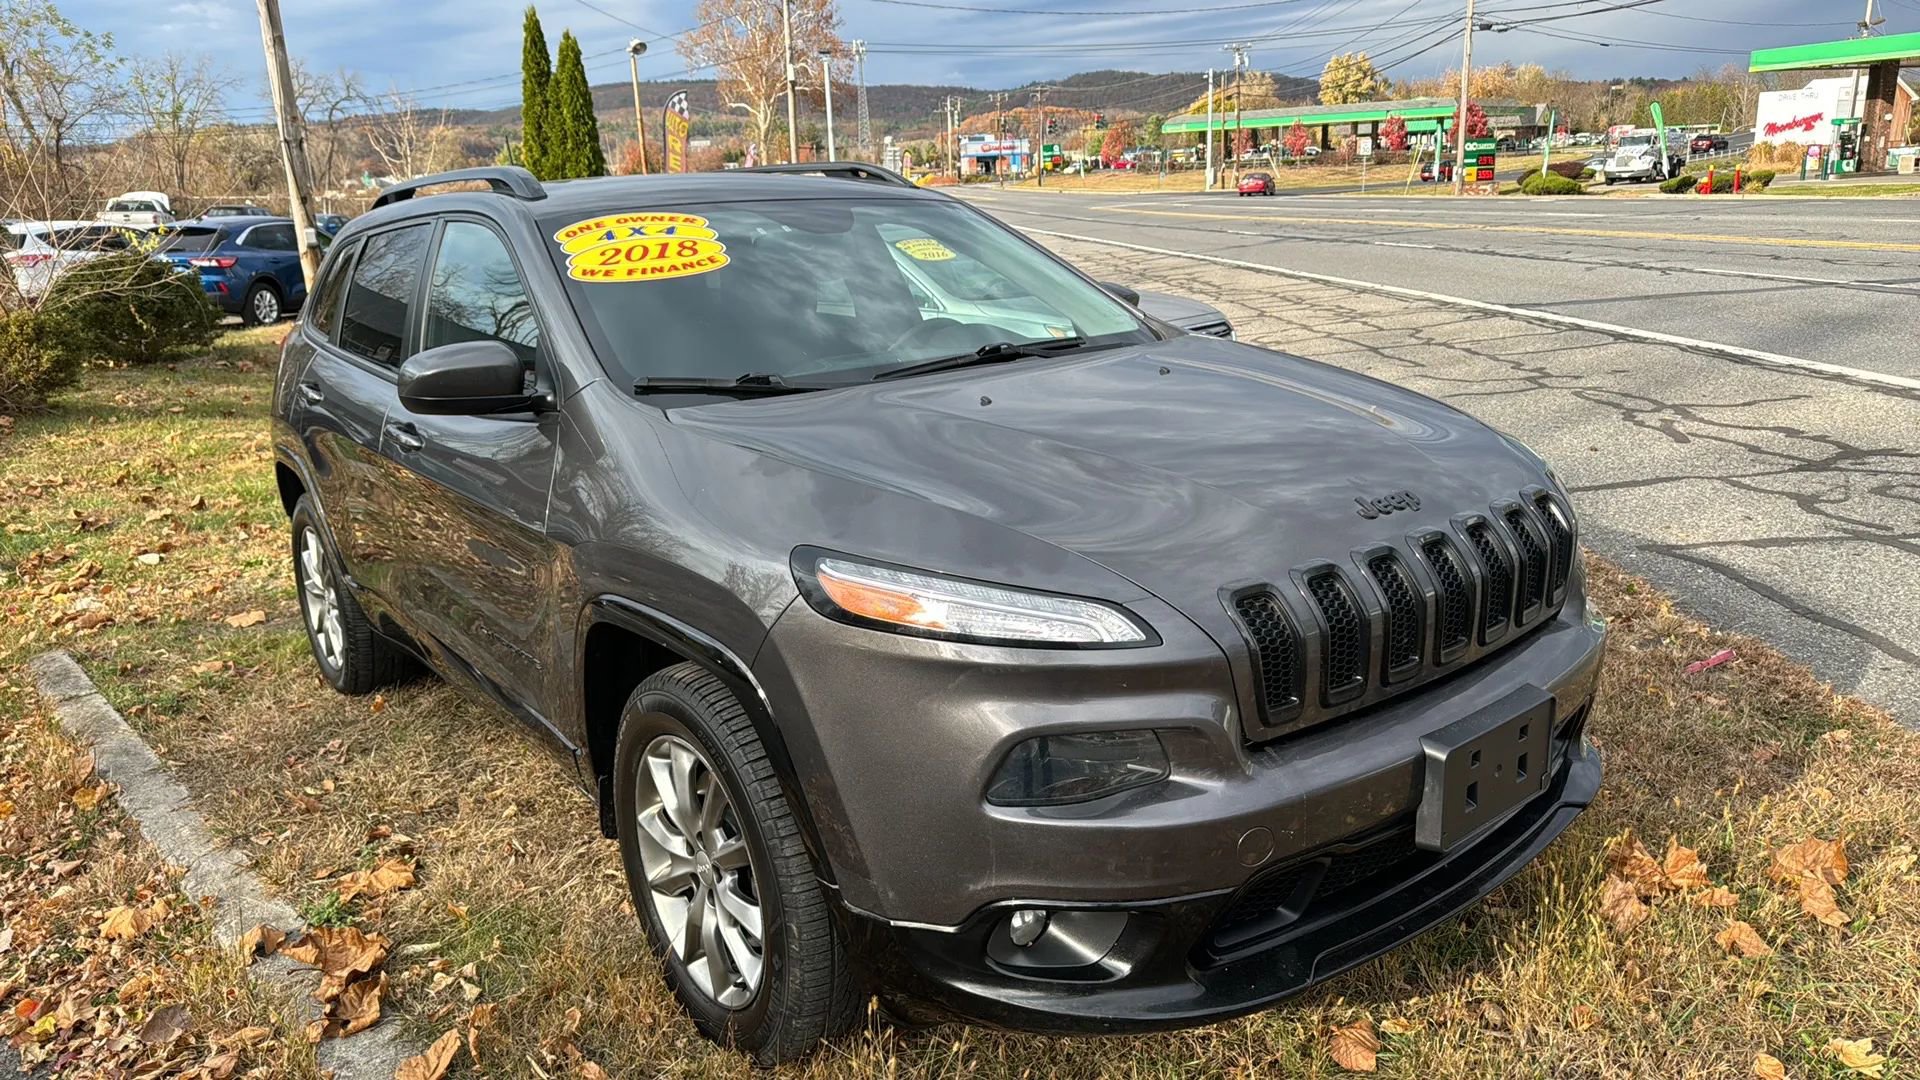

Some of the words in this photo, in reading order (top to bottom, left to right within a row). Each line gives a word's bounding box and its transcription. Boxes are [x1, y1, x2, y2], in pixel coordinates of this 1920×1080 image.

[565, 221, 605, 239] ONE
[616, 215, 698, 225] OWNER
[599, 239, 699, 266] 2018
[581, 268, 616, 277] WE
[626, 255, 721, 276] FINANCE
[1354, 490, 1421, 520] Jeep
